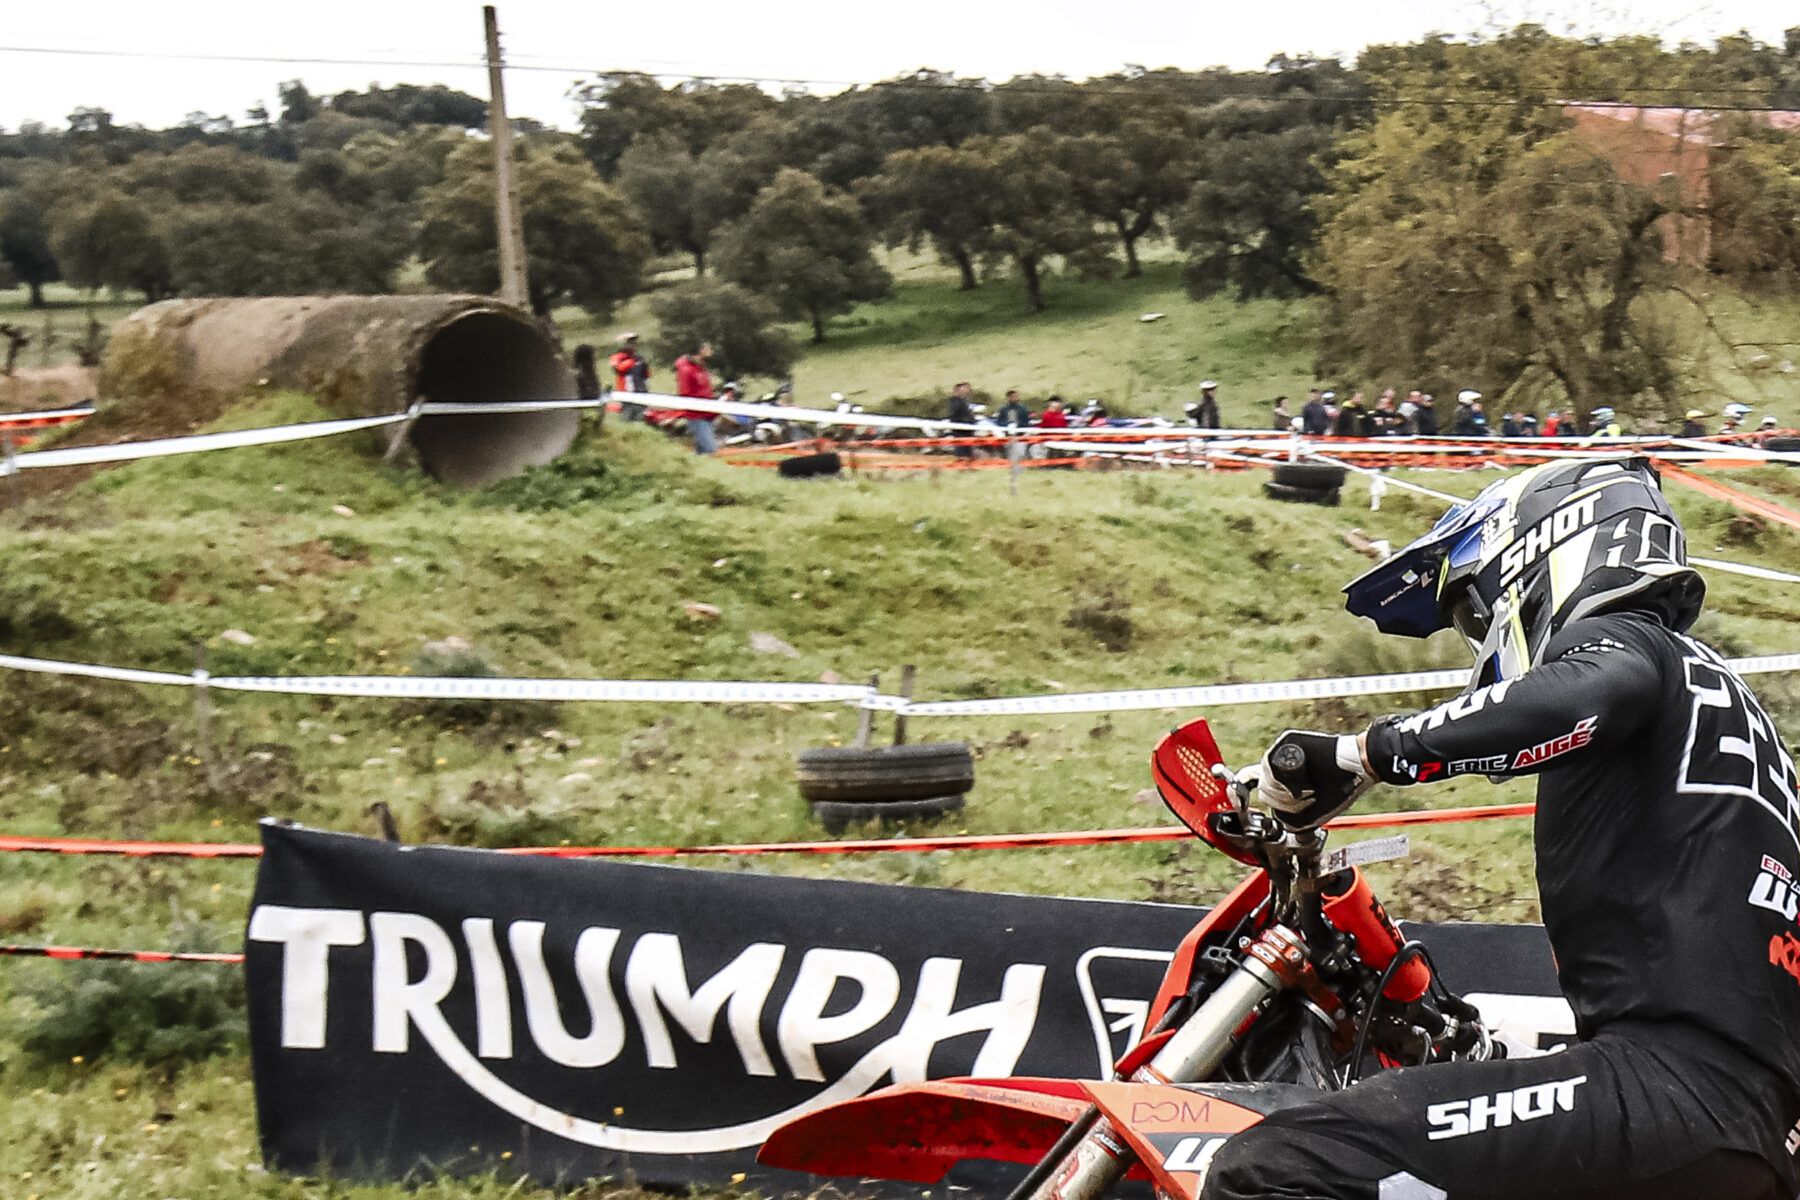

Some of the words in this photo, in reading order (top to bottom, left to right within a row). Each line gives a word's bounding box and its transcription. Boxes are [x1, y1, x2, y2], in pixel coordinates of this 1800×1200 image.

[1500, 492, 1602, 587] SHOT
[1448, 755, 1508, 776] ERIC
[250, 905, 1046, 1156] TRIUMPH
[1426, 1075, 1587, 1141] SHOT
